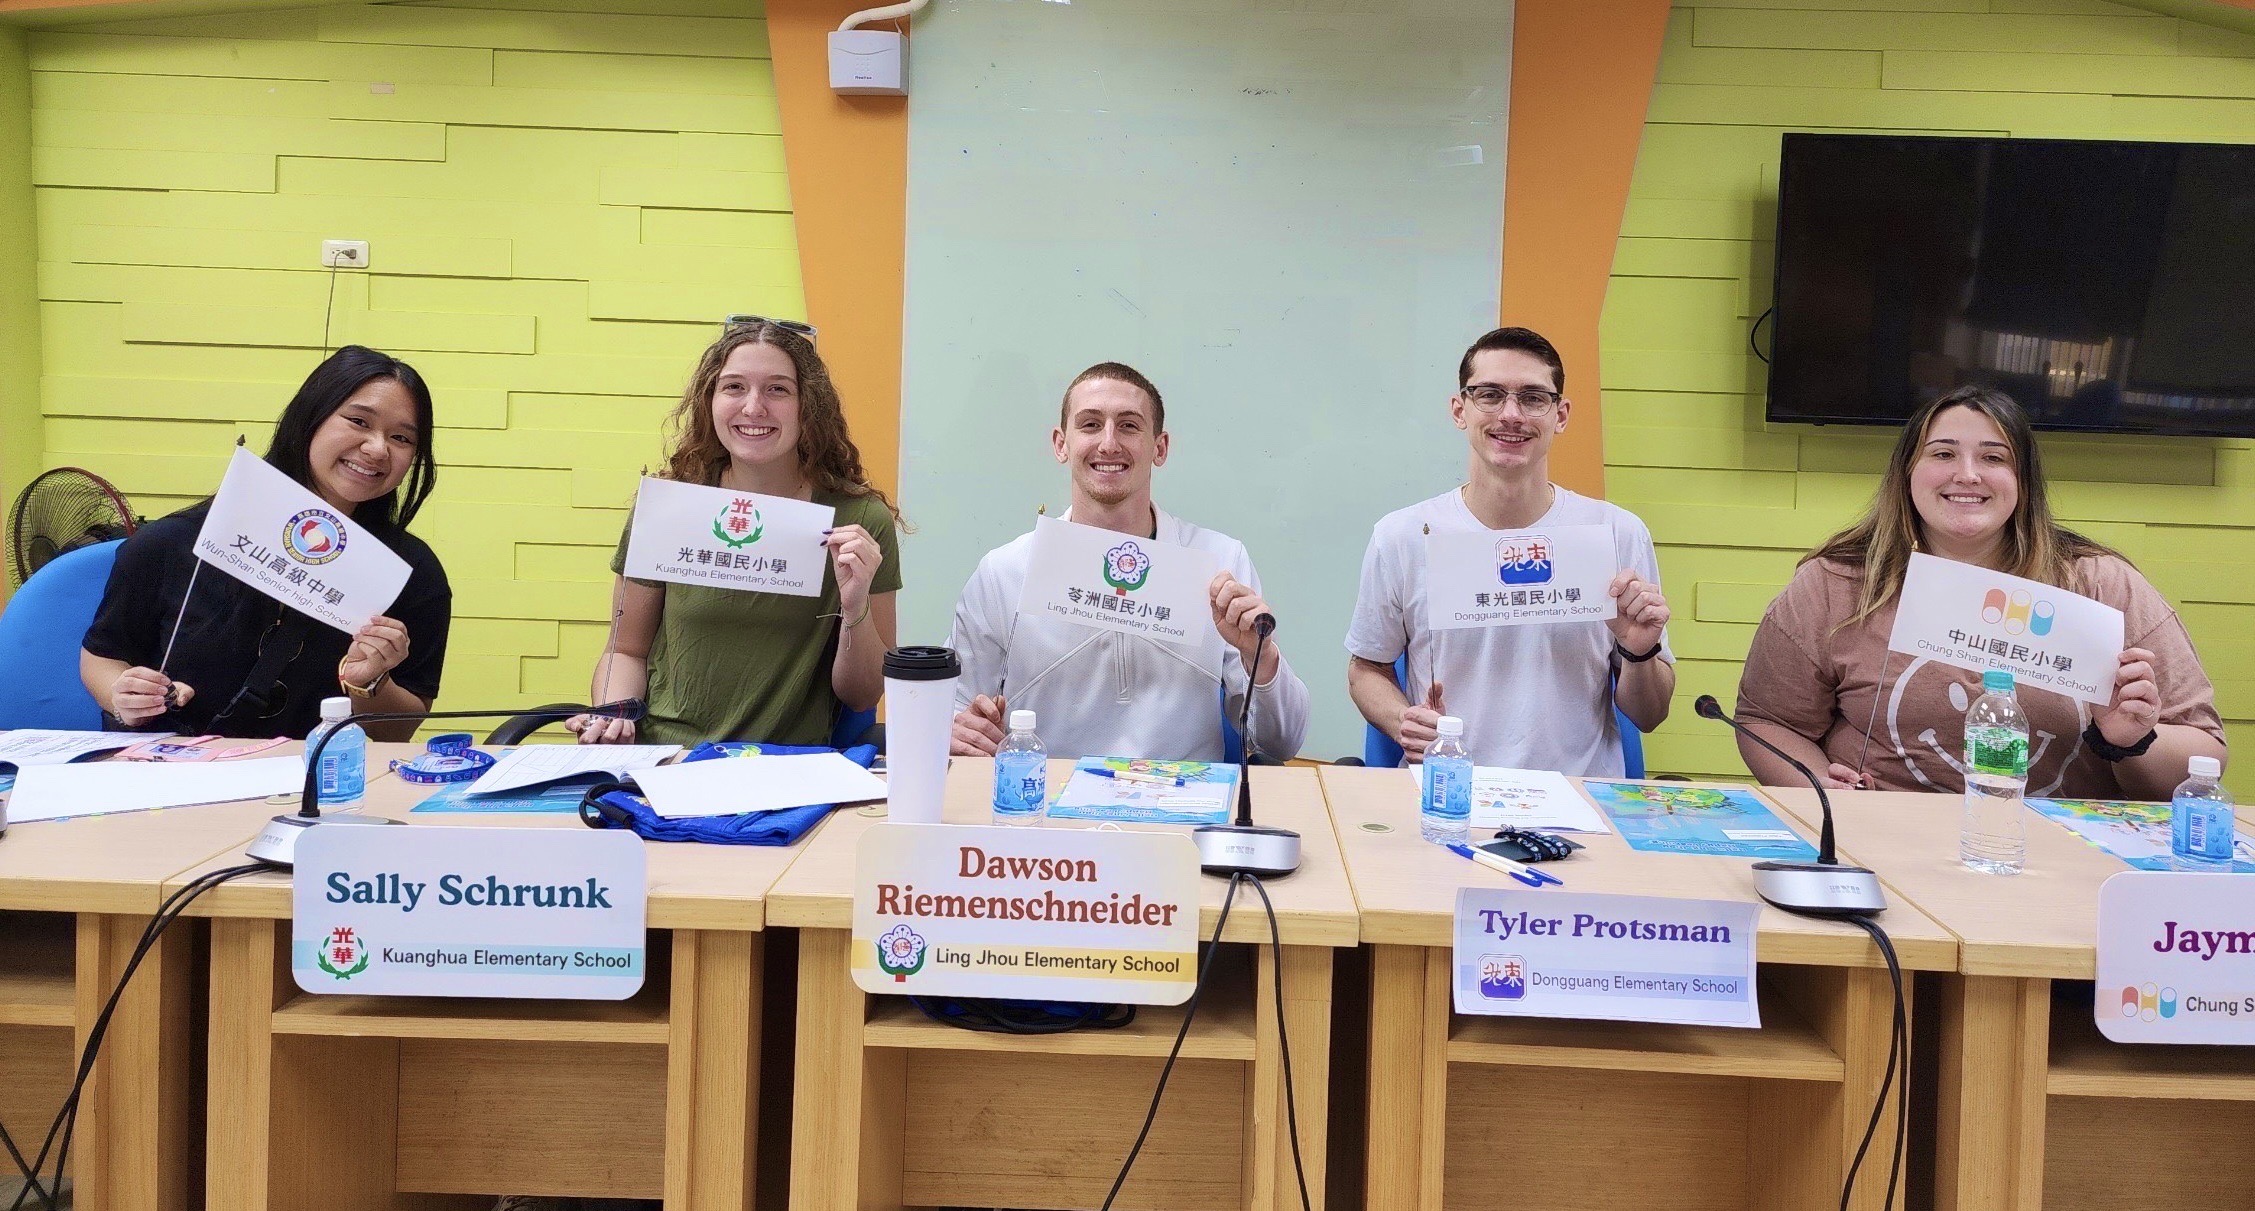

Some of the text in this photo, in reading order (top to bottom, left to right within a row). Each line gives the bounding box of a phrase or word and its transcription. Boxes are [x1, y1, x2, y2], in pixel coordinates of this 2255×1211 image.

[230, 533, 345, 607] 文山高級中學
[655, 562, 804, 588] Kuanghua Elementary School
[677, 547, 787, 575] 光華國民小學
[202, 537, 352, 626] Wun-Shan Senior high School
[1475, 588, 1581, 608] 東光國民小學
[1047, 601, 1185, 637] Ling Jhou Elementary School
[1068, 586, 1171, 622] 苓洲國民小學
[1454, 604, 1603, 622] Dongguang Elementary School
[1917, 639, 2097, 694] Chung Shan Elementary School
[1949, 628, 2073, 673] 中山國民小學
[958, 846, 1097, 882] Dawson
[326, 872, 613, 913] Sally Schrunk
[876, 884, 1178, 927] Riemenschneider
[1478, 909, 1732, 944] Tyler Protsman
[383, 948, 631, 970] Kuanghua Elementary School
[936, 948, 1179, 974] Ling Jhou Elementary School
[1532, 972, 1738, 994] Dongguang Elementary School
[2186, 996, 2238, 1016] Chung
